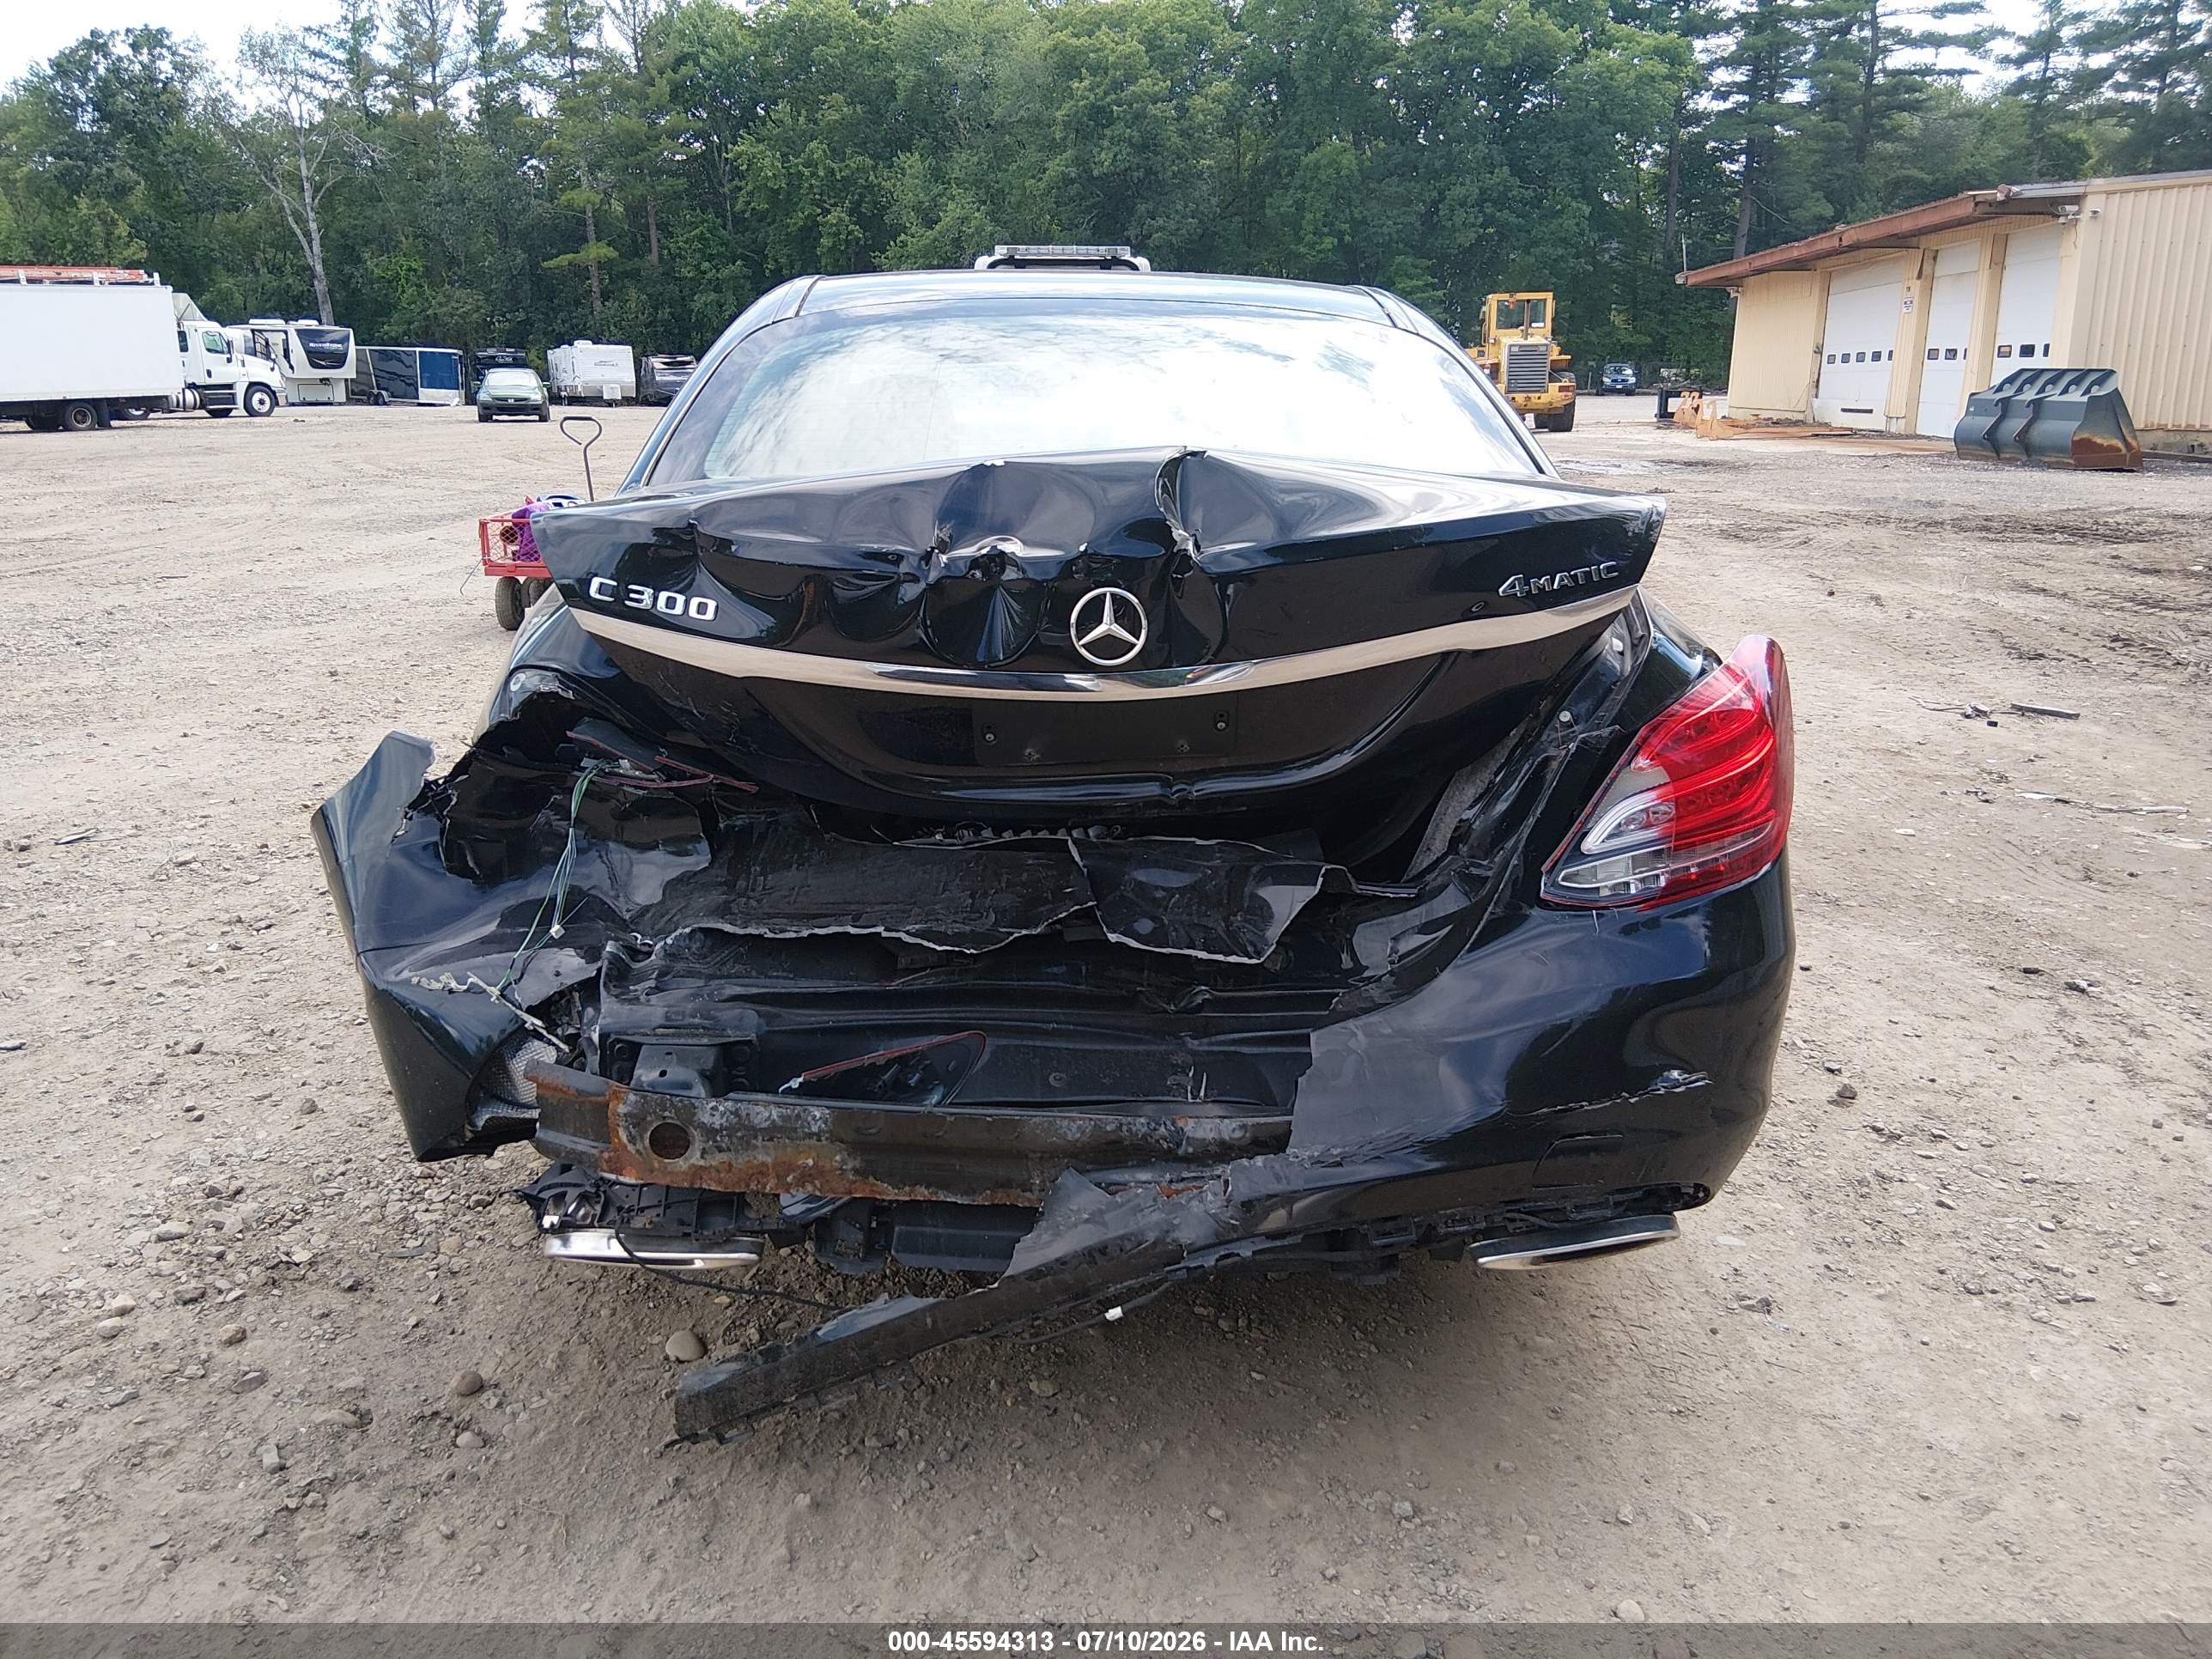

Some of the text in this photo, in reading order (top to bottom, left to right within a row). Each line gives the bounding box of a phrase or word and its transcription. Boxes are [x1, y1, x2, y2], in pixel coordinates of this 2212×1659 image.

[588, 576, 719, 621] C 300
[1498, 562, 1620, 597] 4MATIC
